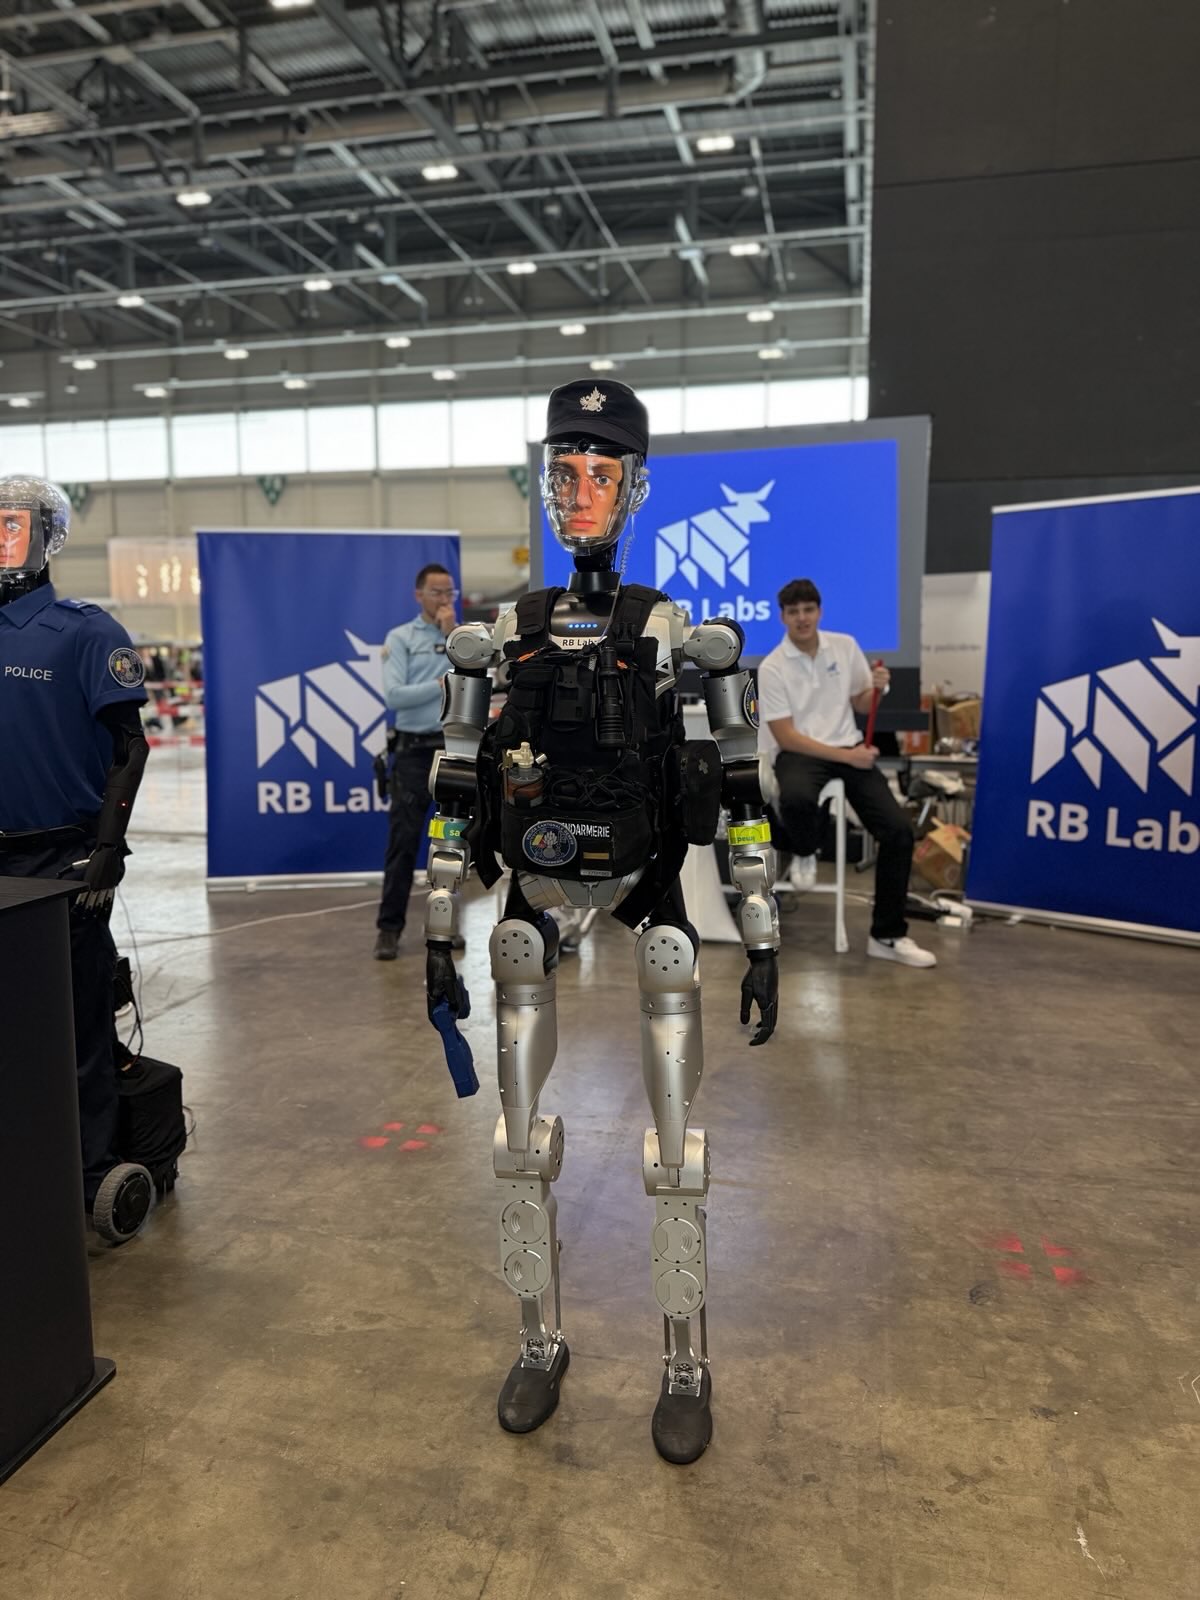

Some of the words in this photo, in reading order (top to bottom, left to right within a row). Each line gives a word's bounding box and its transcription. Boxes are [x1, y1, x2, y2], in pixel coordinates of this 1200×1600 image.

[701, 595, 771, 622] Labs
[562, 639, 575, 647] RB
[577, 639, 598, 647] Lab
[4, 666, 53, 681] POLICE
[257, 780, 313, 814] RB
[324, 779, 392, 814] Lab
[561, 823, 610, 838] NDARMERIE
[1026, 799, 1089, 842] RB
[1105, 806, 1200, 855] Lab
